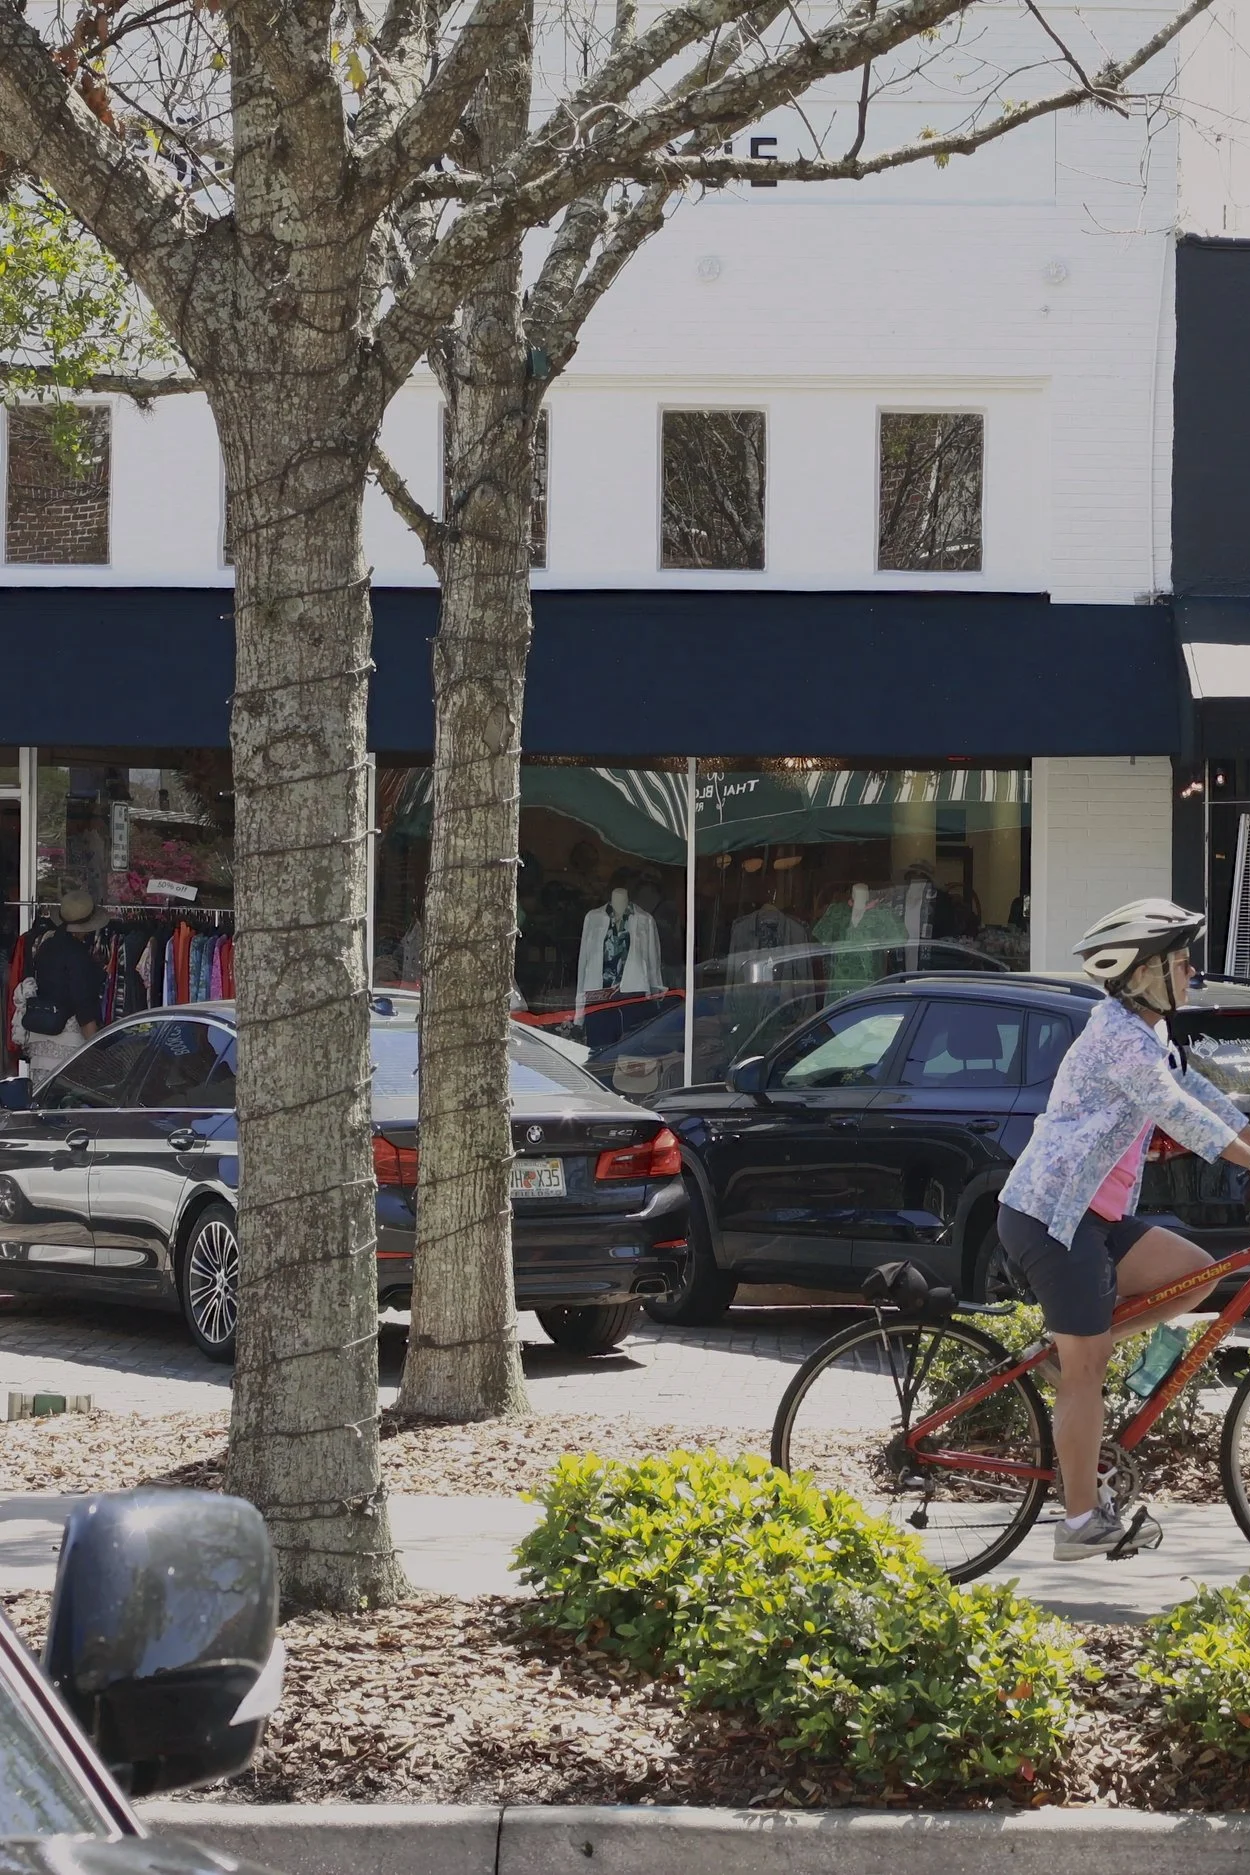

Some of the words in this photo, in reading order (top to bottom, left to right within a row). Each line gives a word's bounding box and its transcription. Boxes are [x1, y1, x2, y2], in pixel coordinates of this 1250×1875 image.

[157, 880, 174, 890] 50%
[538, 1169, 560, 1187] X35
[1146, 1261, 1233, 1304] cannondale
